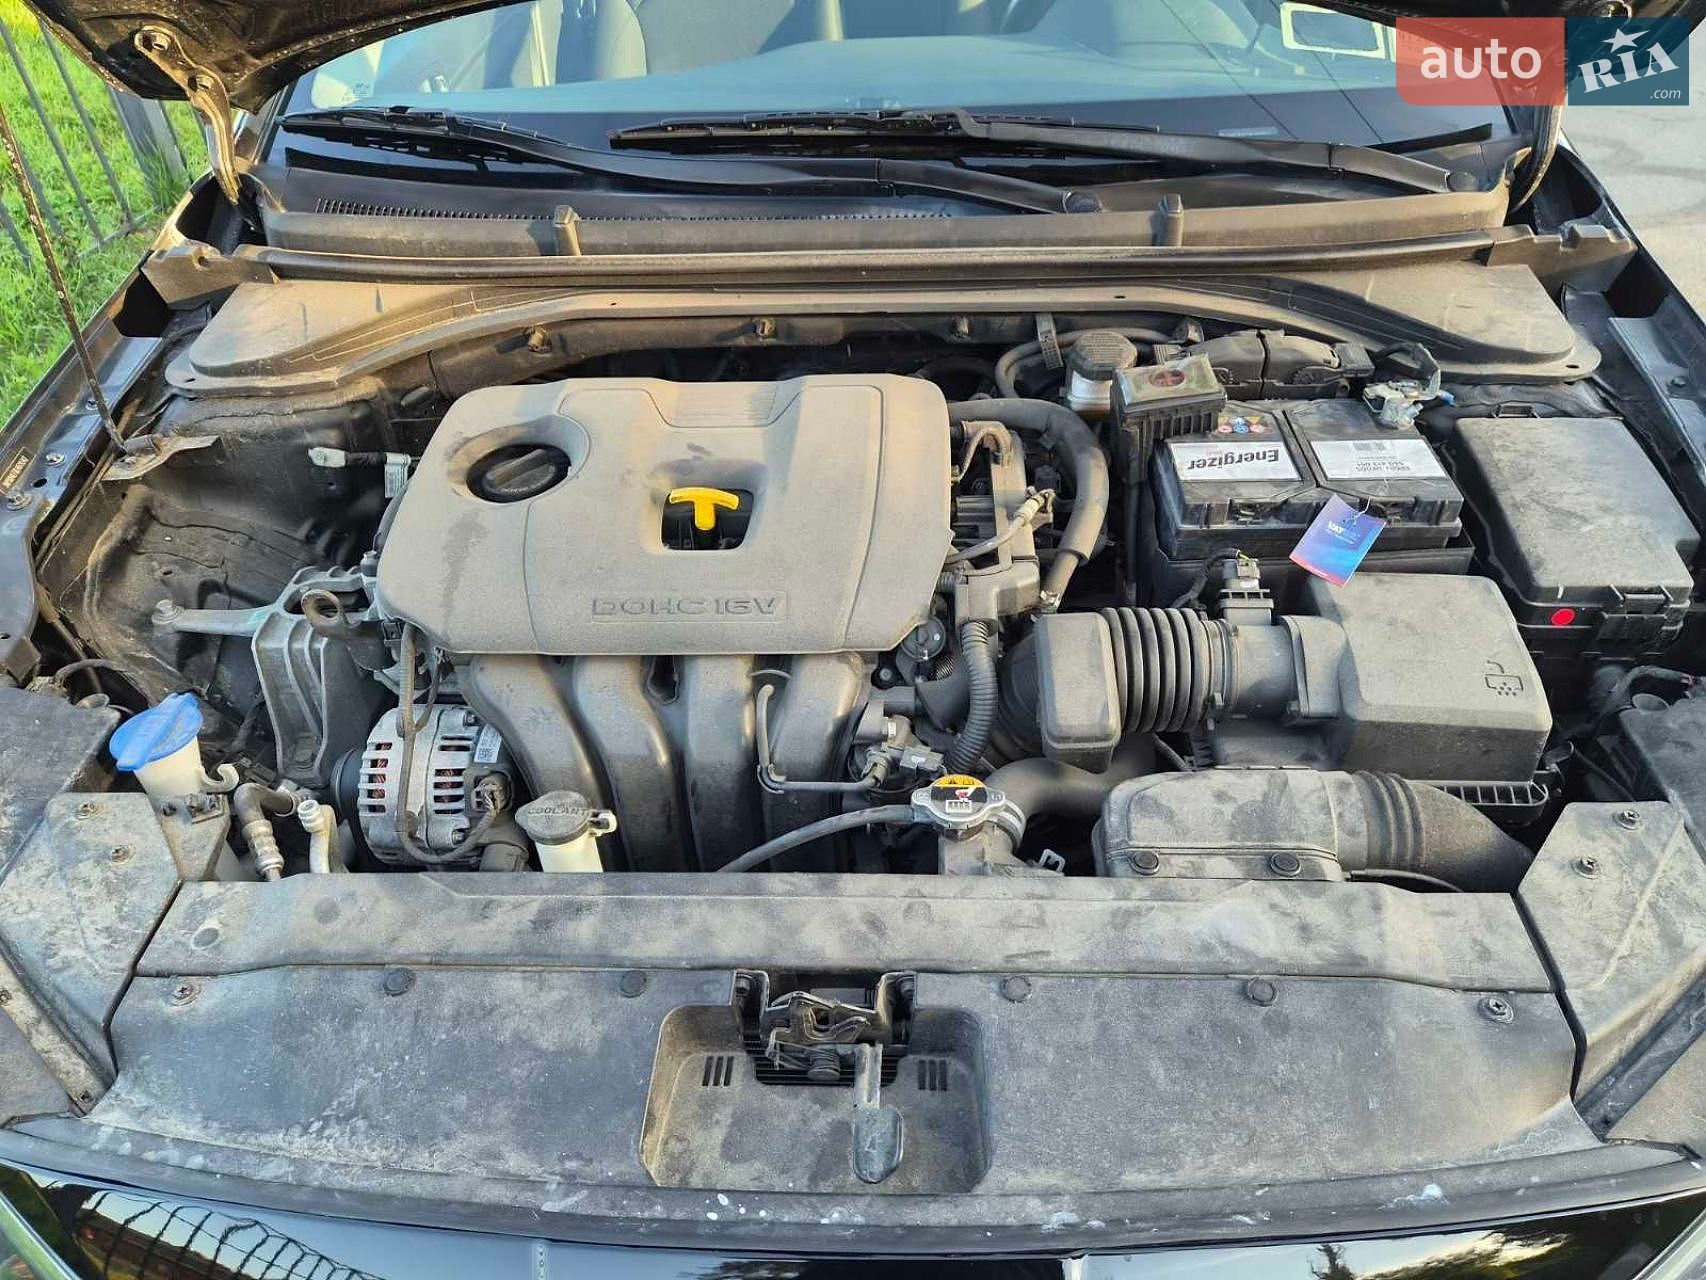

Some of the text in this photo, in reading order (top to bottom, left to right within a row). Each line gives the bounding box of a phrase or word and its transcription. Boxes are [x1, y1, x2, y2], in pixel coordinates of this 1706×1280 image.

[1187, 449, 1279, 470] Energizer
[592, 598, 777, 616] DOHC 16V
[527, 805, 587, 817] COOLANT
